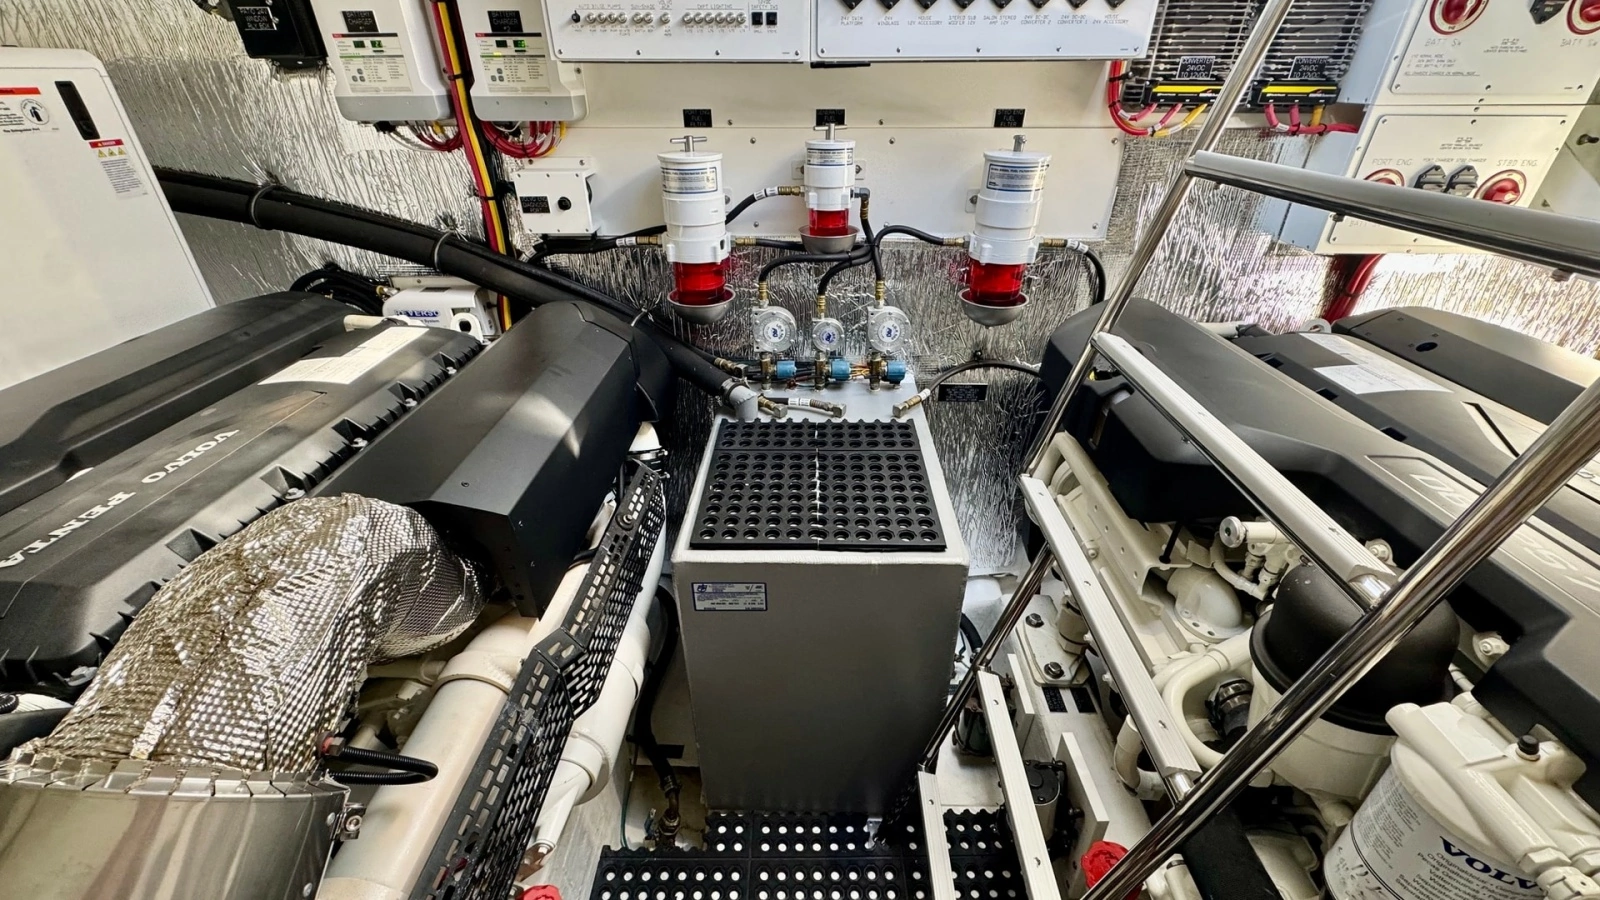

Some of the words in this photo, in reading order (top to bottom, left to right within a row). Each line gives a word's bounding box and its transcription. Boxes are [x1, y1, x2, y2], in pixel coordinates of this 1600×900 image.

[1425, 38, 1448, 46] BATT
[141, 430, 240, 484] VOLVO
[0, 492, 136, 568] PENTA
[1440, 836, 1549, 897] VOLV
